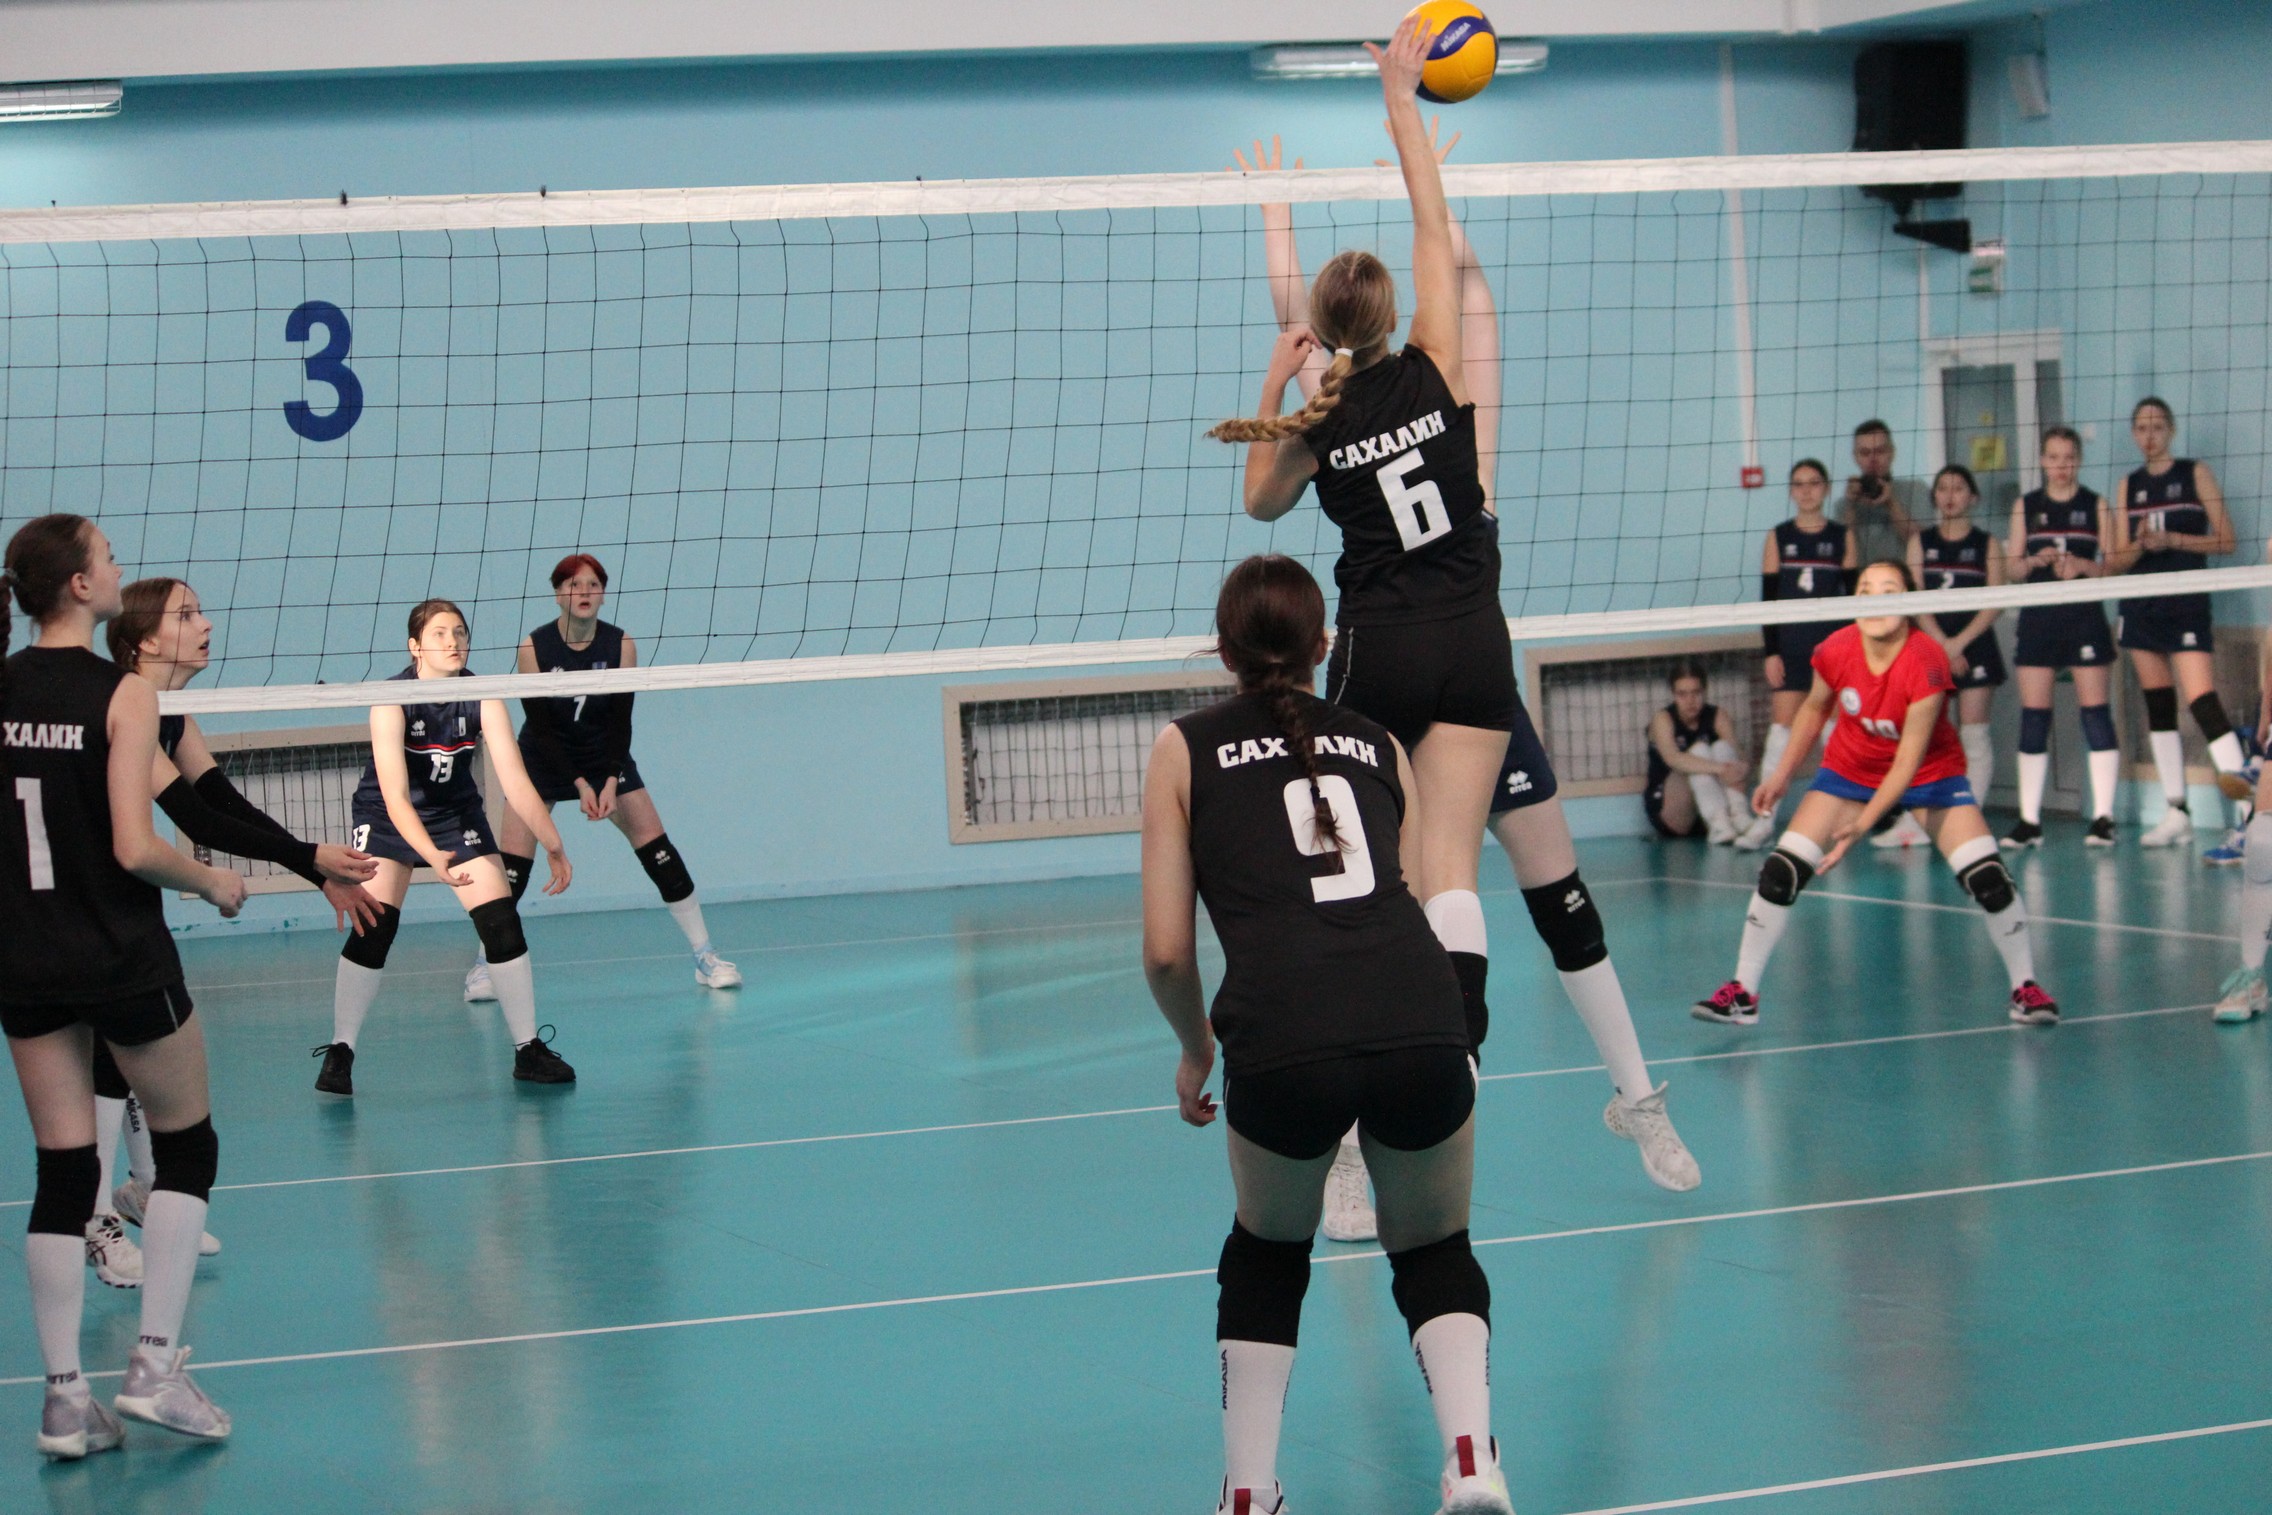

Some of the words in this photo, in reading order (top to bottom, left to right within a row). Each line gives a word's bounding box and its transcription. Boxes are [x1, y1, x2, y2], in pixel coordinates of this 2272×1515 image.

[283, 300, 364, 442] 3
[1329, 410, 1447, 471] САХАЛИН
[1376, 447, 1453, 552] 6
[1797, 567, 1815, 593] 4
[573, 695, 588, 722] 7
[429, 753, 454, 784] 13
[1216, 735, 1379, 770] САХЛИН
[15, 777, 55, 890] 1
[352, 824, 371, 852] 13
[1283, 774, 1377, 904] 9
